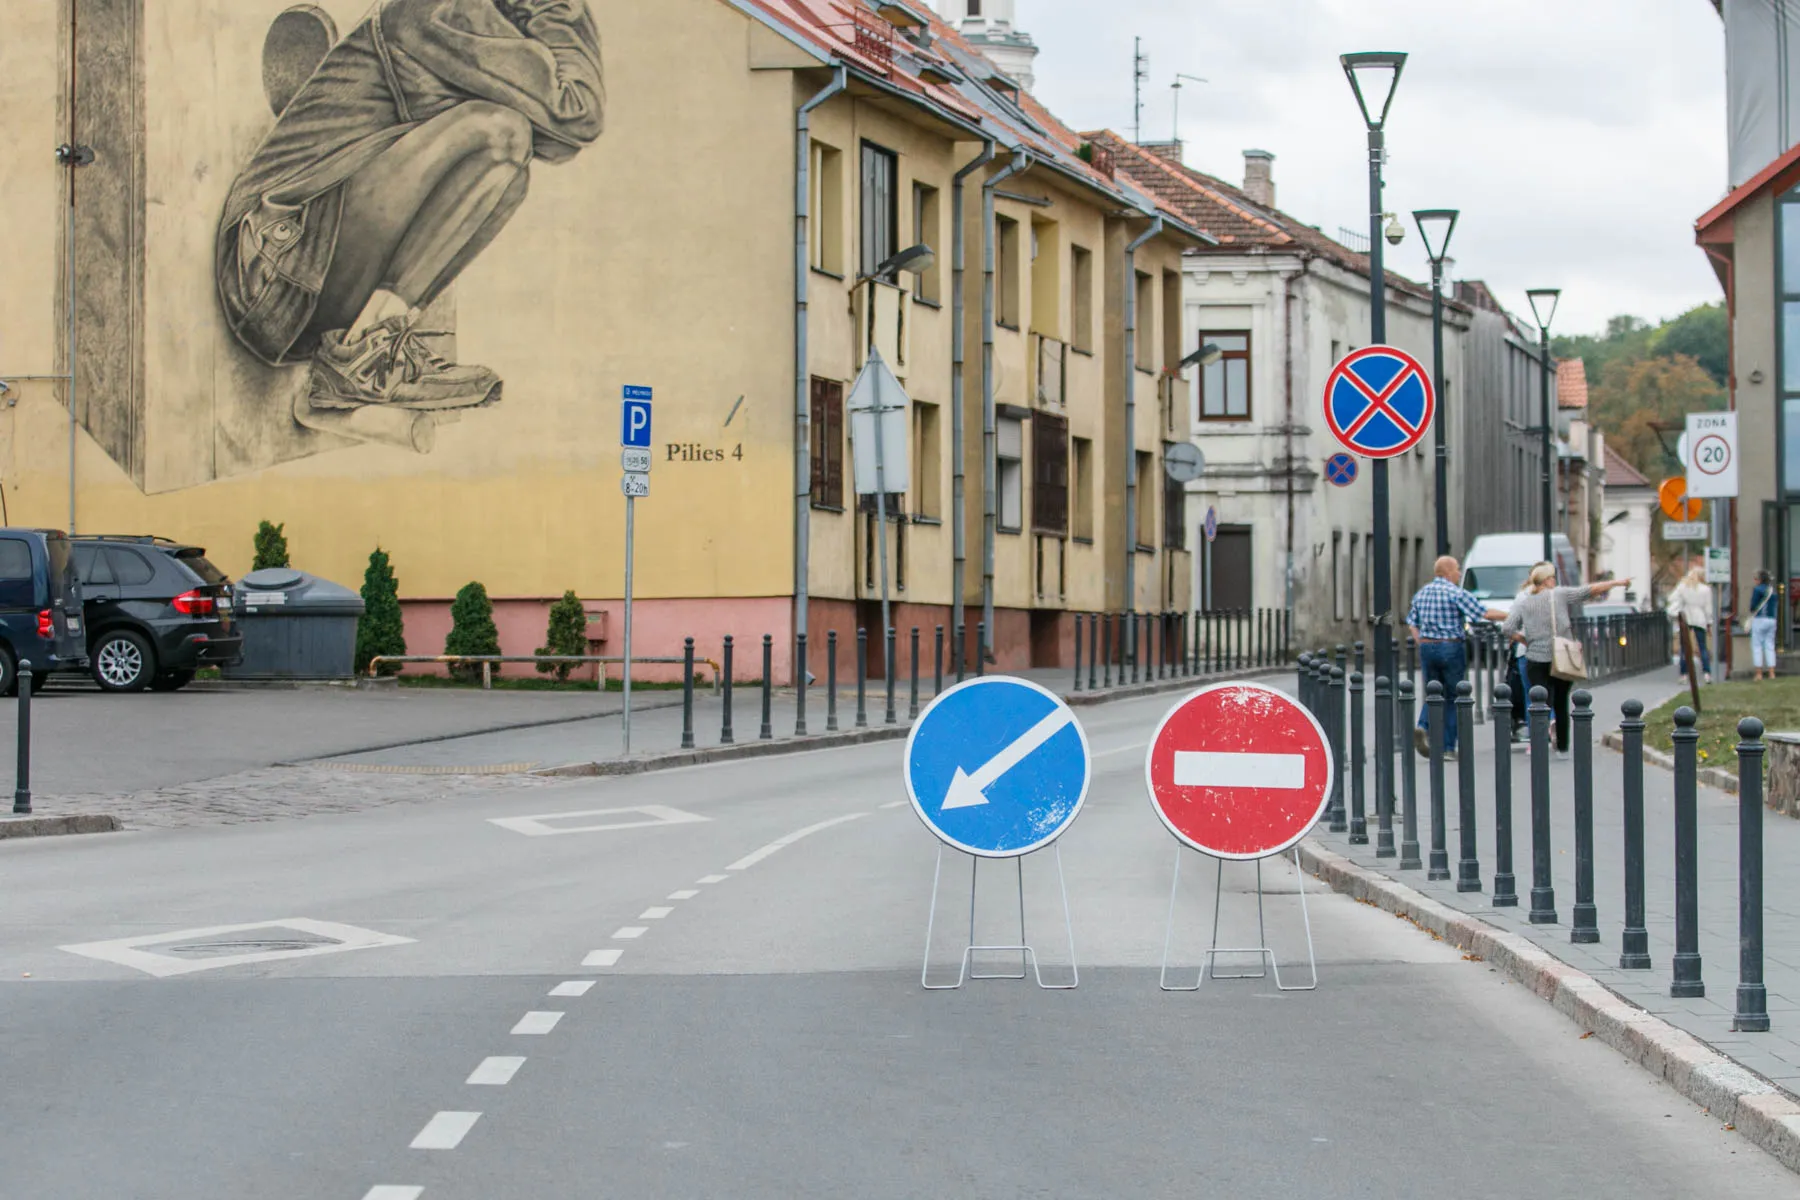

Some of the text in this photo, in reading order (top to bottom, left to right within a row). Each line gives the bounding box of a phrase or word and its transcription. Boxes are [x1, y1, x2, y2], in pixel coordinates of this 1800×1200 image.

[630, 406, 647, 441] P
[1697, 418, 1727, 429] ZONA
[666, 442, 743, 461] Pilies 4
[1703, 446, 1724, 463] 20
